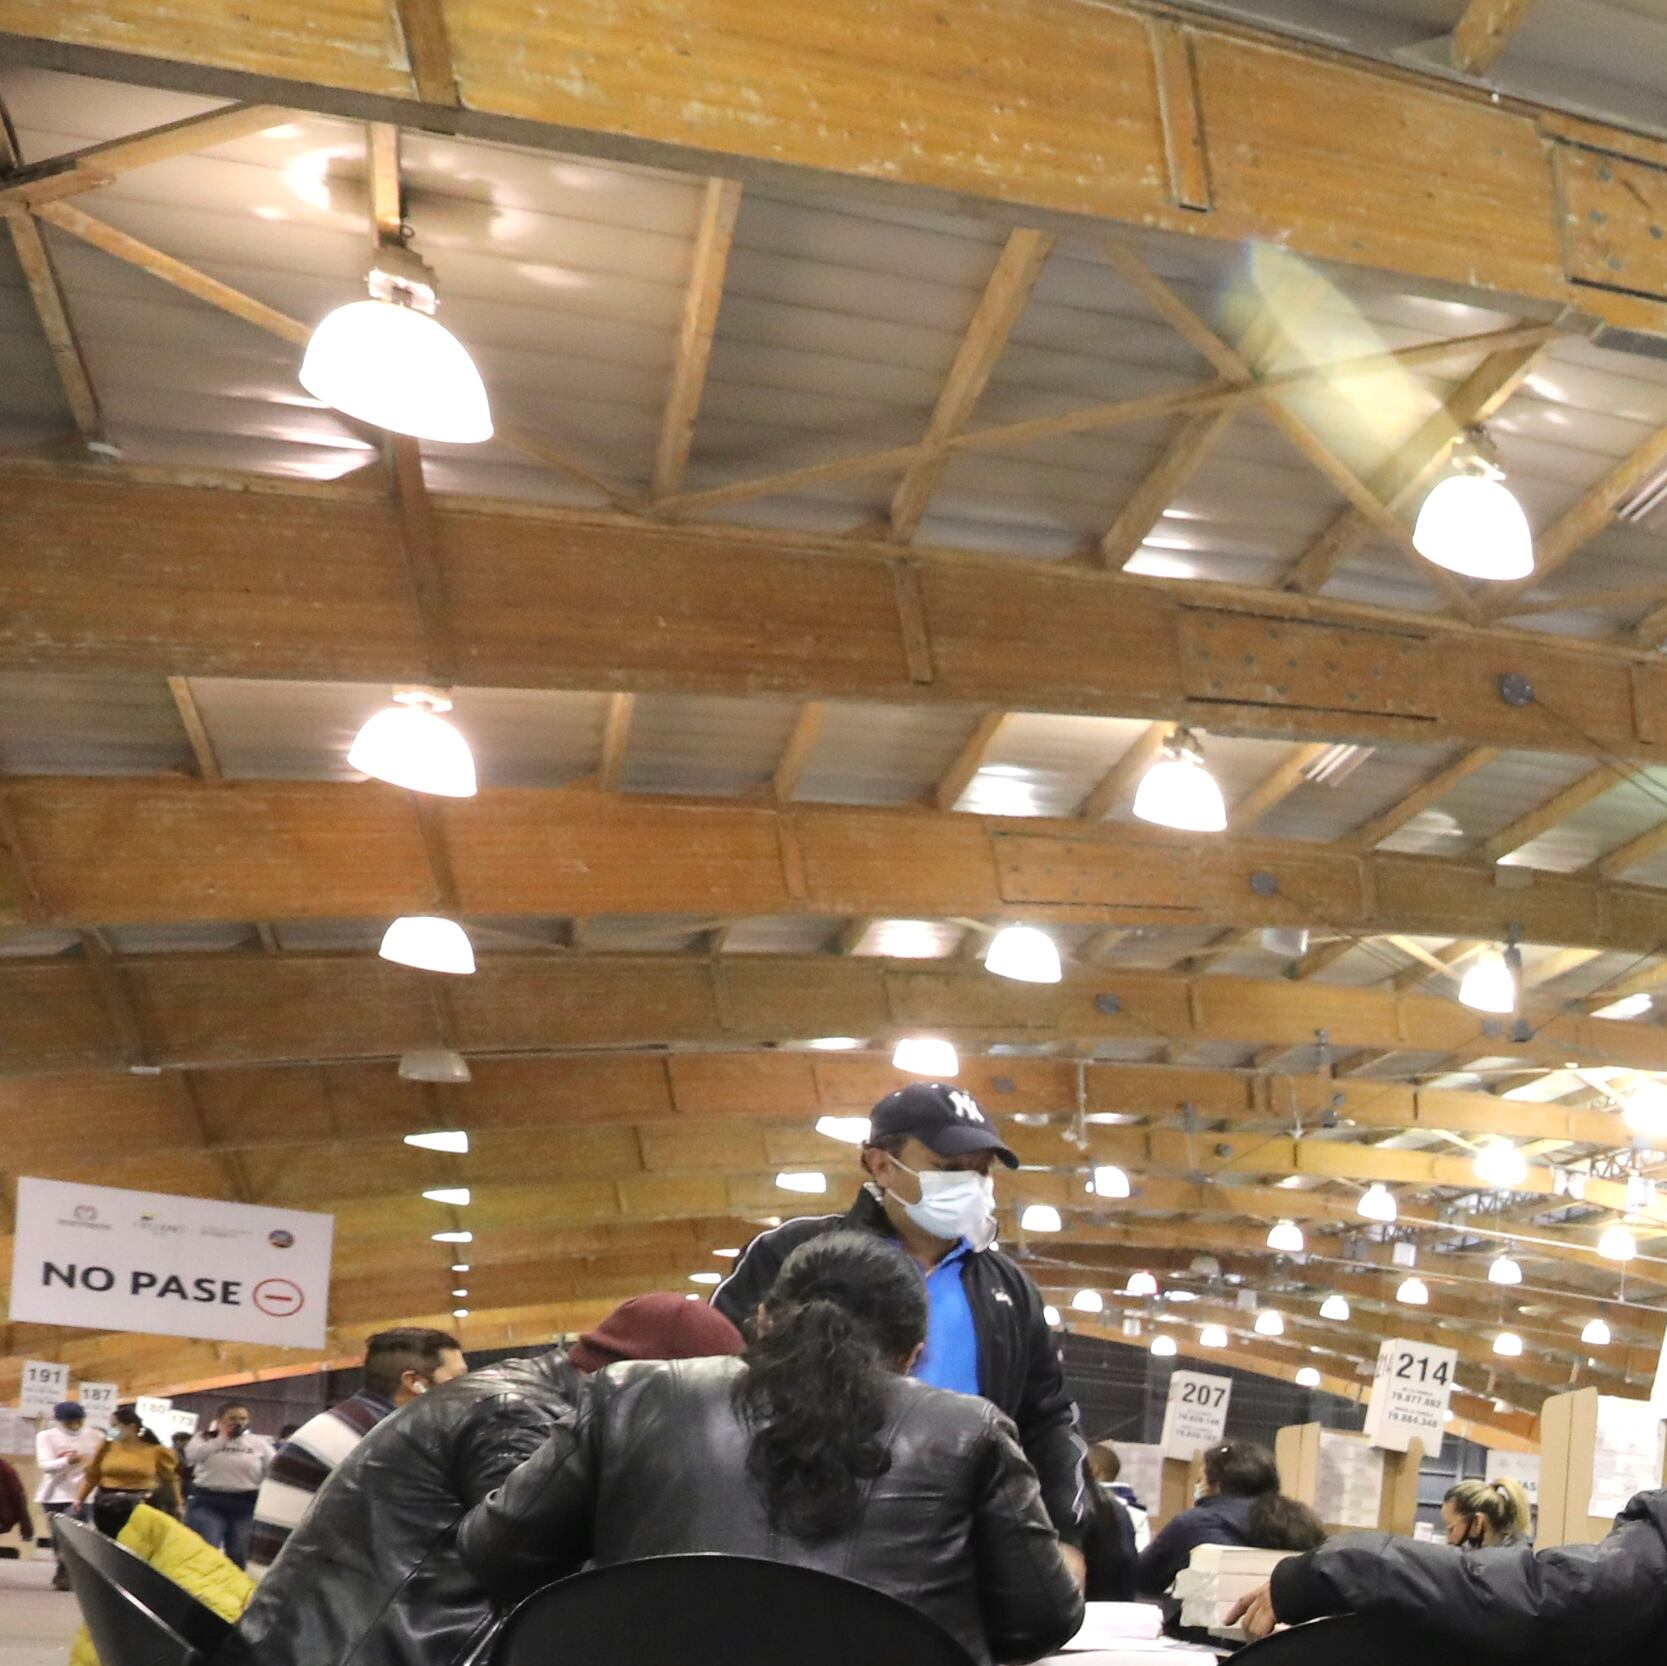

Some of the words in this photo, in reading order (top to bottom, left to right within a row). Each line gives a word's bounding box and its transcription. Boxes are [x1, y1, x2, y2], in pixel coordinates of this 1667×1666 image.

[42, 1261, 115, 1292] NO
[130, 1271, 243, 1306] PASE
[28, 1368, 62, 1384] 191
[1396, 1353, 1448, 1386] 214
[82, 1388, 112, 1401] 187
[1182, 1382, 1226, 1408] 207
